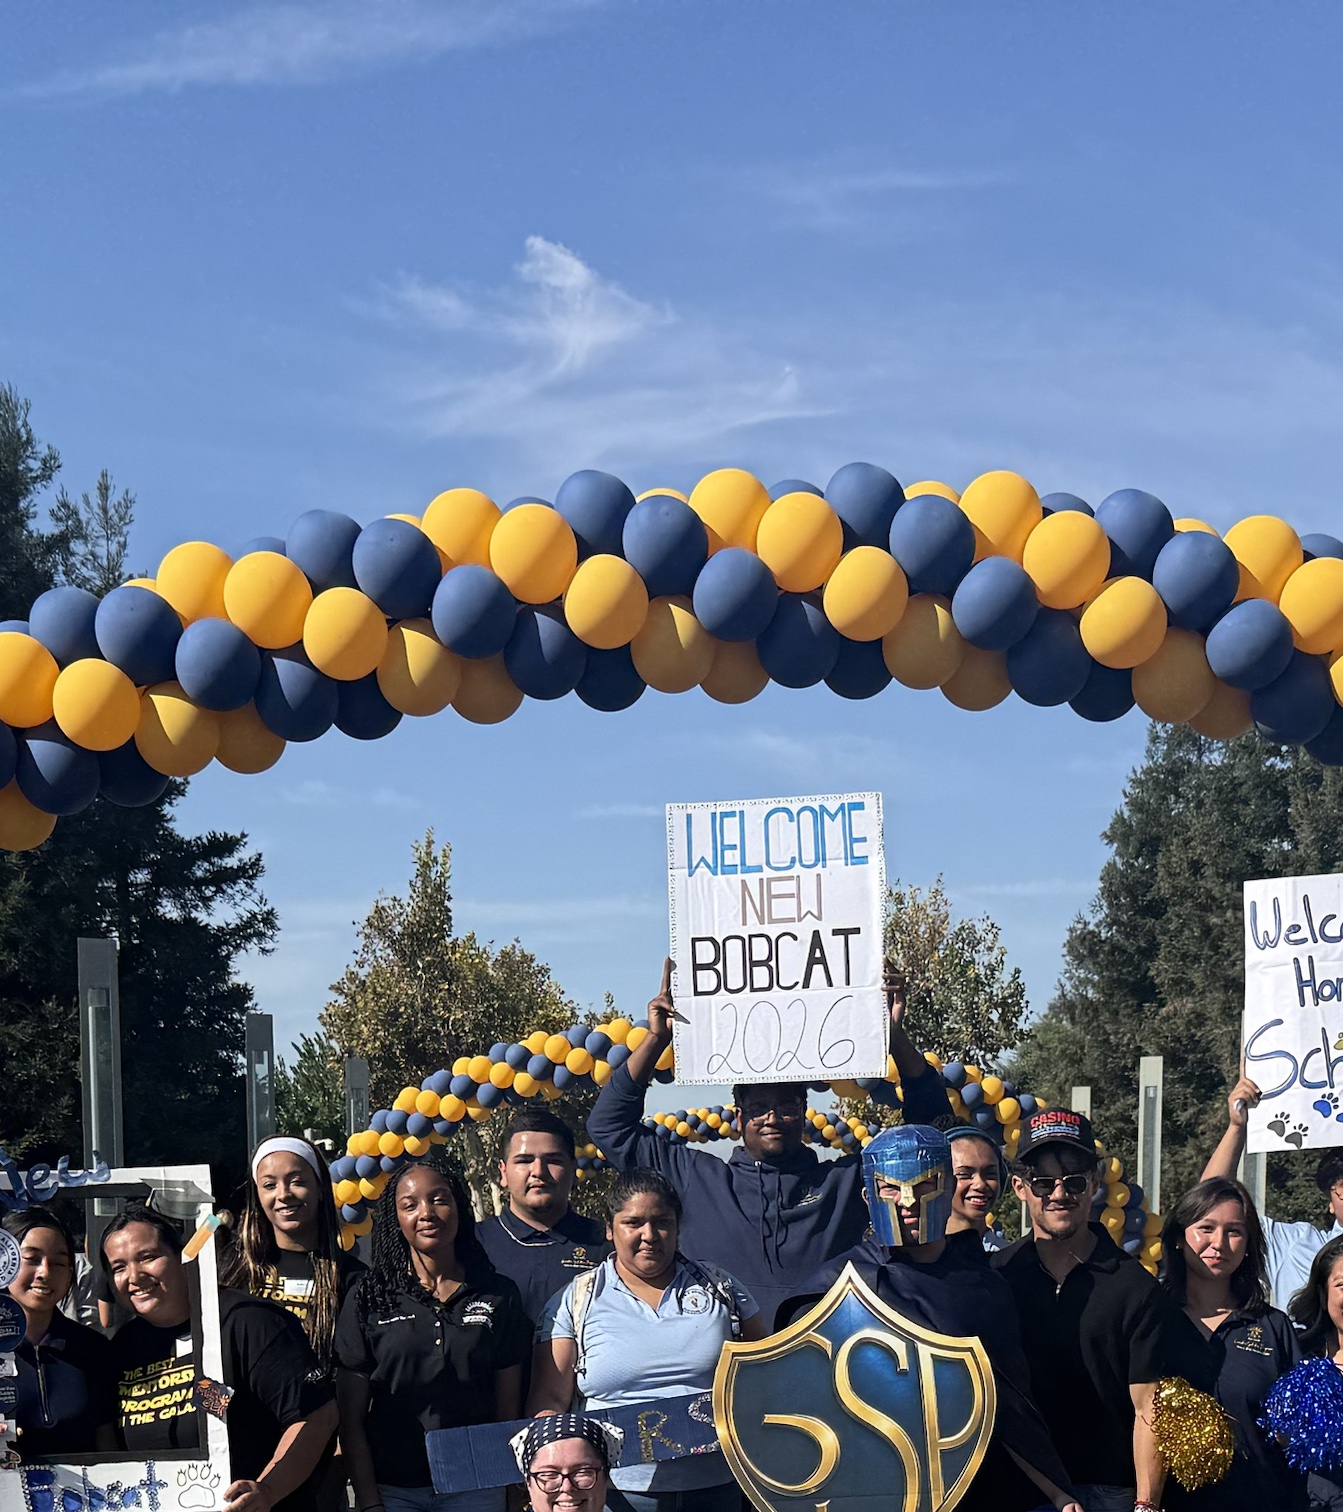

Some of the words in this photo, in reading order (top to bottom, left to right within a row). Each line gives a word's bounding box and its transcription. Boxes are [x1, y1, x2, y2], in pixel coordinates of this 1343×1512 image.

[685, 801, 869, 878] WELCOME
[740, 873, 823, 927] NEW
[690, 927, 861, 997] BOBCAT
[706, 994, 855, 1076] 2026
[1030, 1111, 1081, 1128] CASINO
[123, 1366, 143, 1381] THE
[146, 1357, 176, 1376] BEST
[129, 1411, 156, 1426] THE
